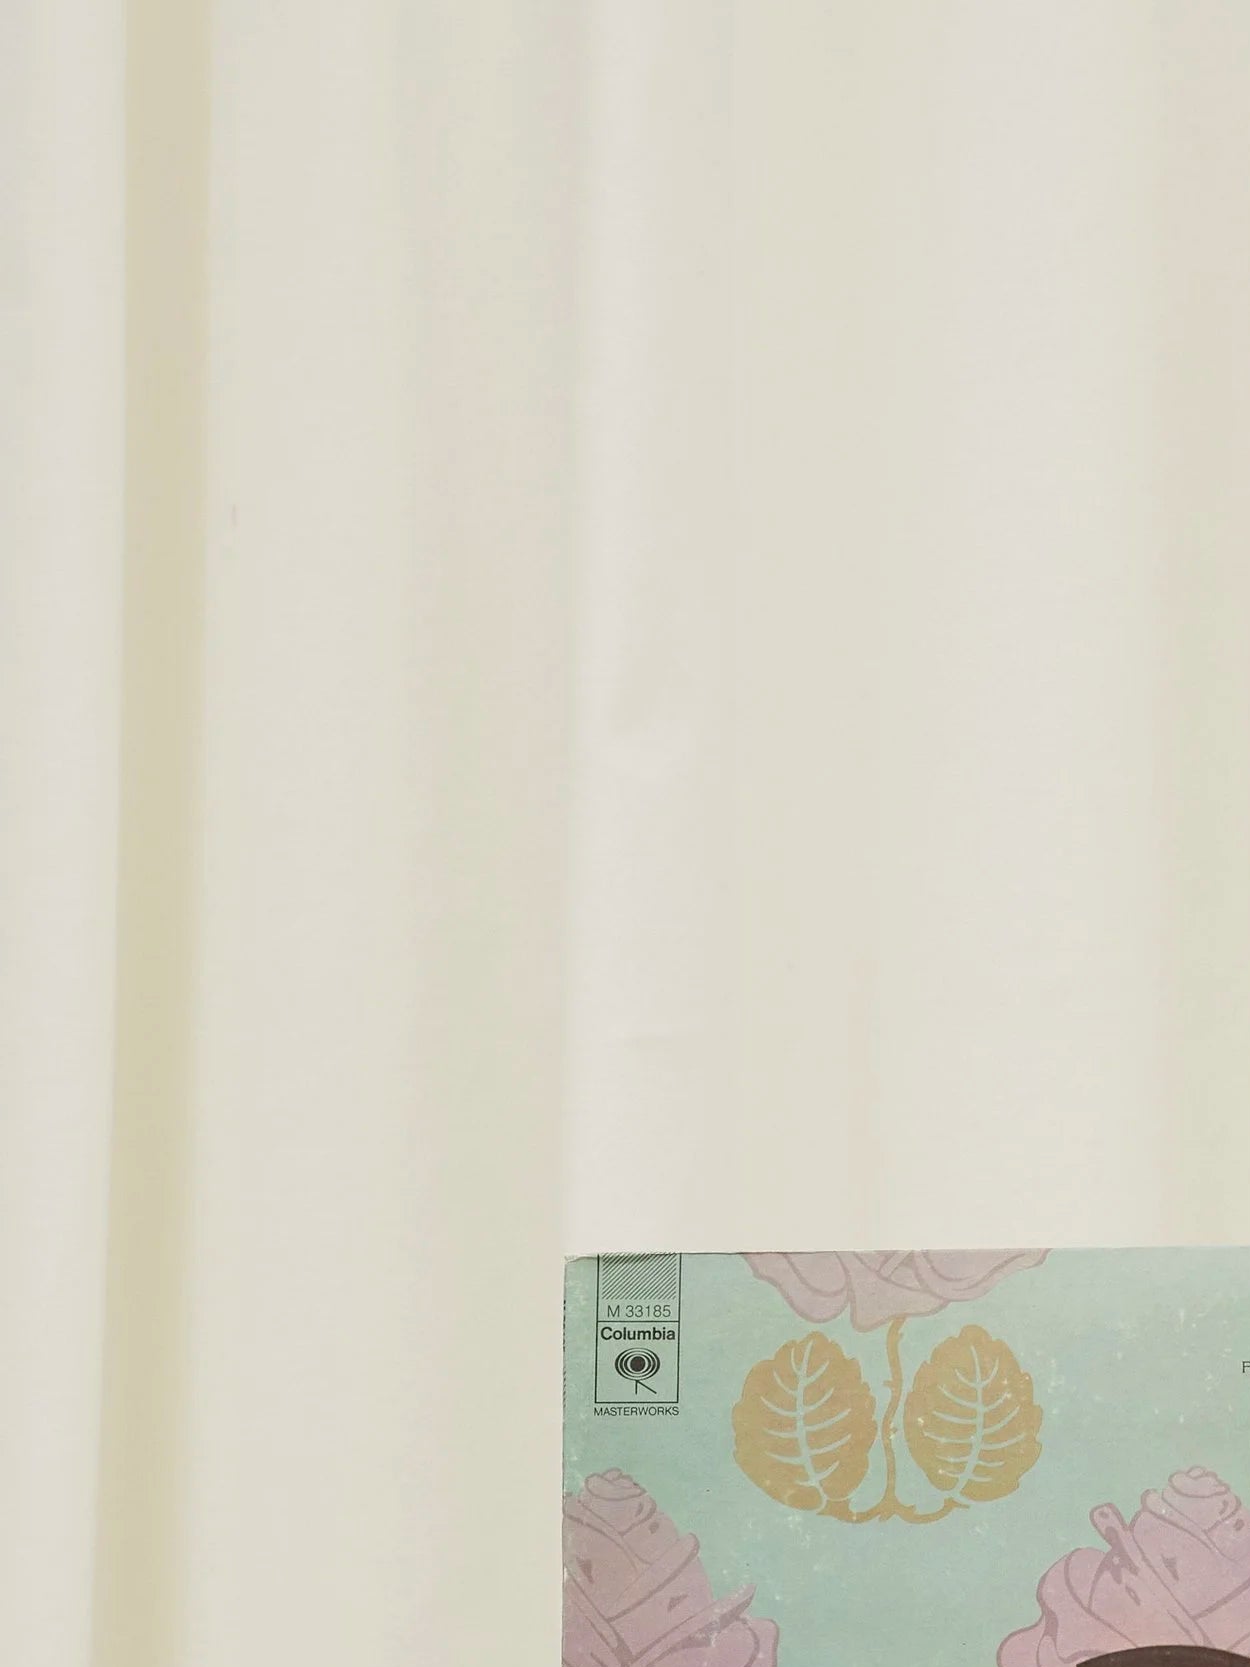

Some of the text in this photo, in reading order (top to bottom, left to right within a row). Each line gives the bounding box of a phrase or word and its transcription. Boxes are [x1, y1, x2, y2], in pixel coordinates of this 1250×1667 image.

[607, 1304, 671, 1318] M 33185
[600, 1326, 676, 1341] Columbia
[593, 1406, 680, 1417] MASTERWORKS
